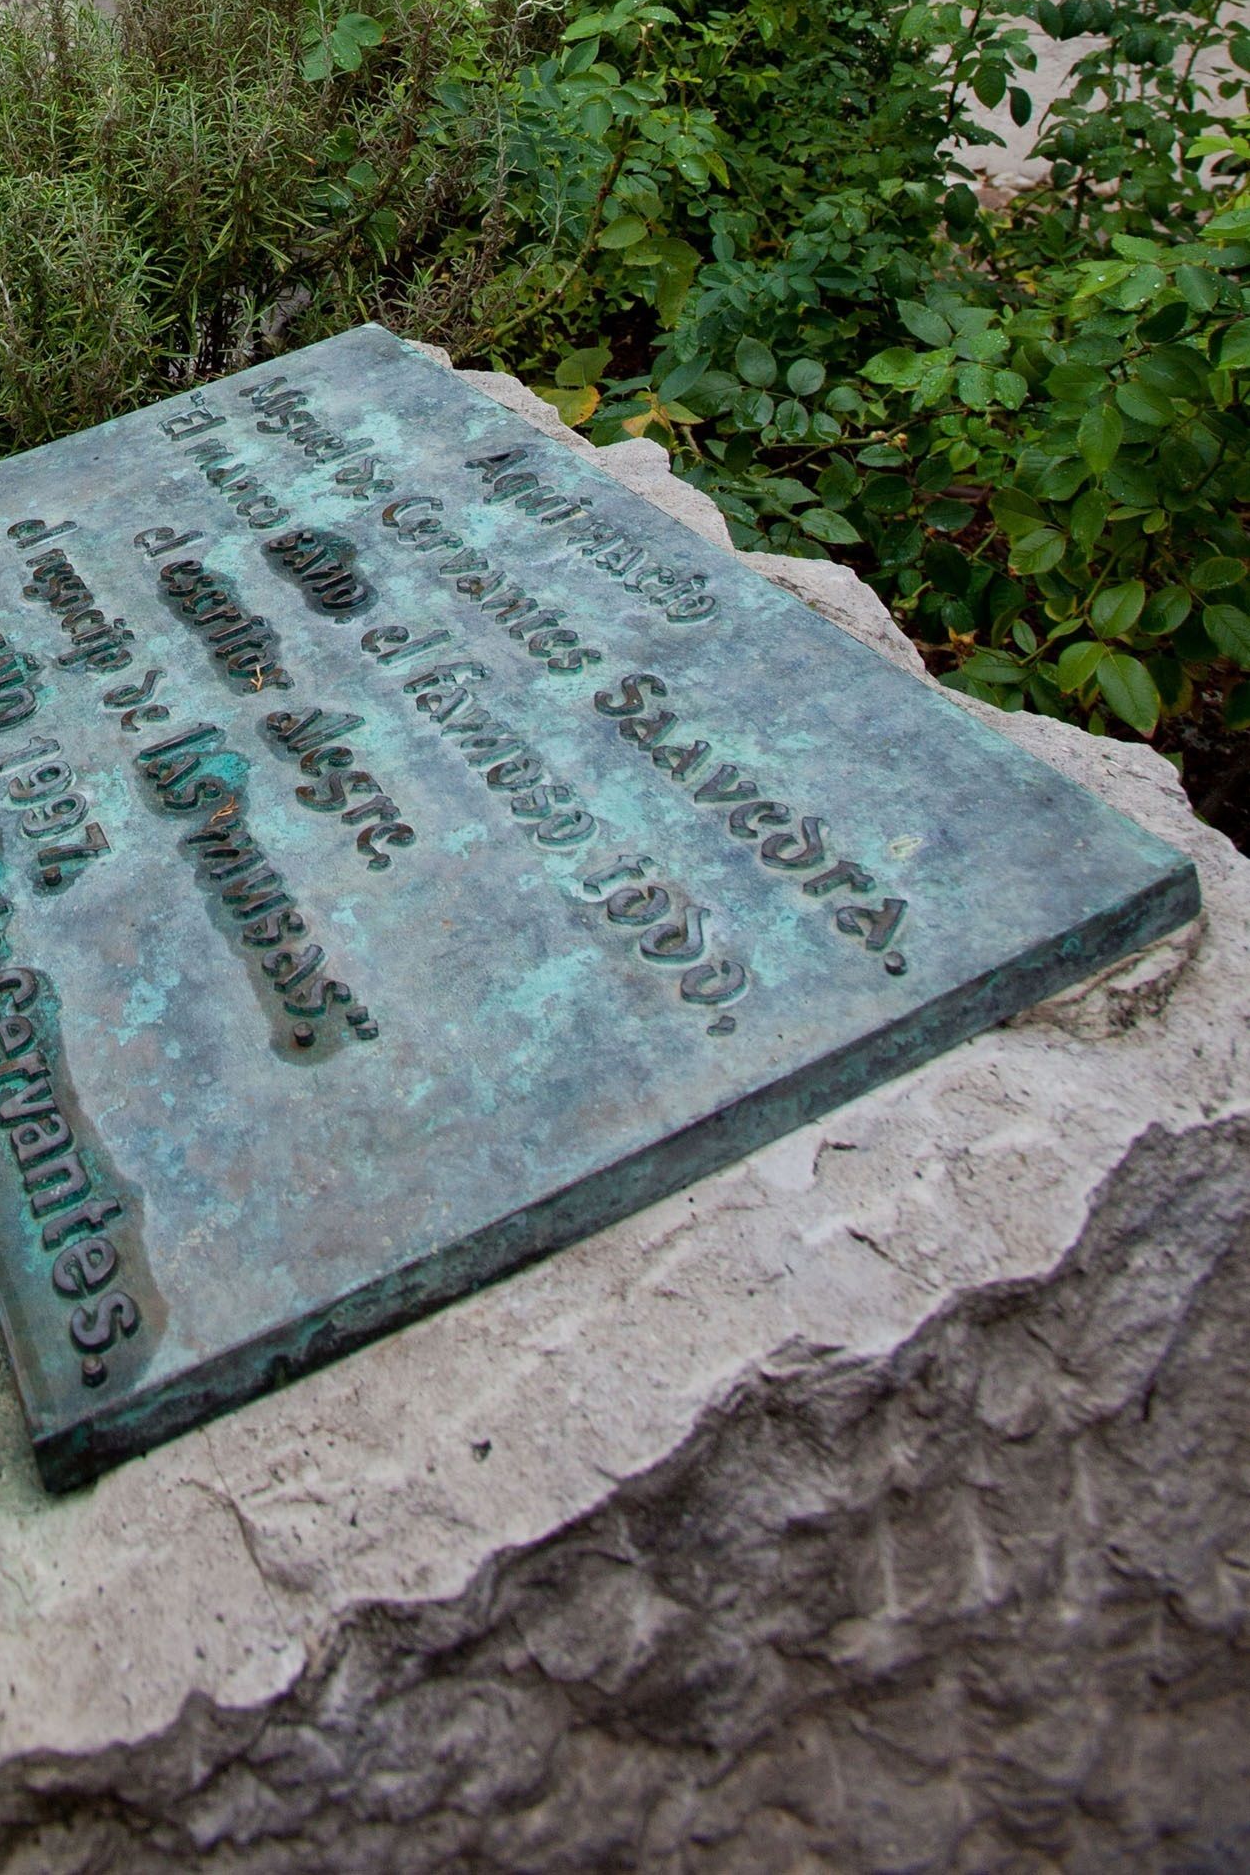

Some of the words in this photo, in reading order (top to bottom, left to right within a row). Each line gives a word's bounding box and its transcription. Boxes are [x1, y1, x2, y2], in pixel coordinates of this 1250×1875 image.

[7, 519, 78, 549] el
[184, 437, 291, 528] manco
[133, 526, 203, 559] el
[22, 548, 136, 673] regocijo
[160, 559, 296, 694] escritor
[360, 625, 451, 666] el
[103, 669, 172, 733] de
[238, 376, 375, 464] Miguel
[335, 458, 395, 501] de
[381, 496, 602, 674] Cervantes
[594, 674, 908, 976] Saavedra.
[139, 722, 222, 809] las
[403, 661, 598, 846] famoso
[0, 735, 111, 886] 1997.
[582, 854, 747, 1036] todo,
